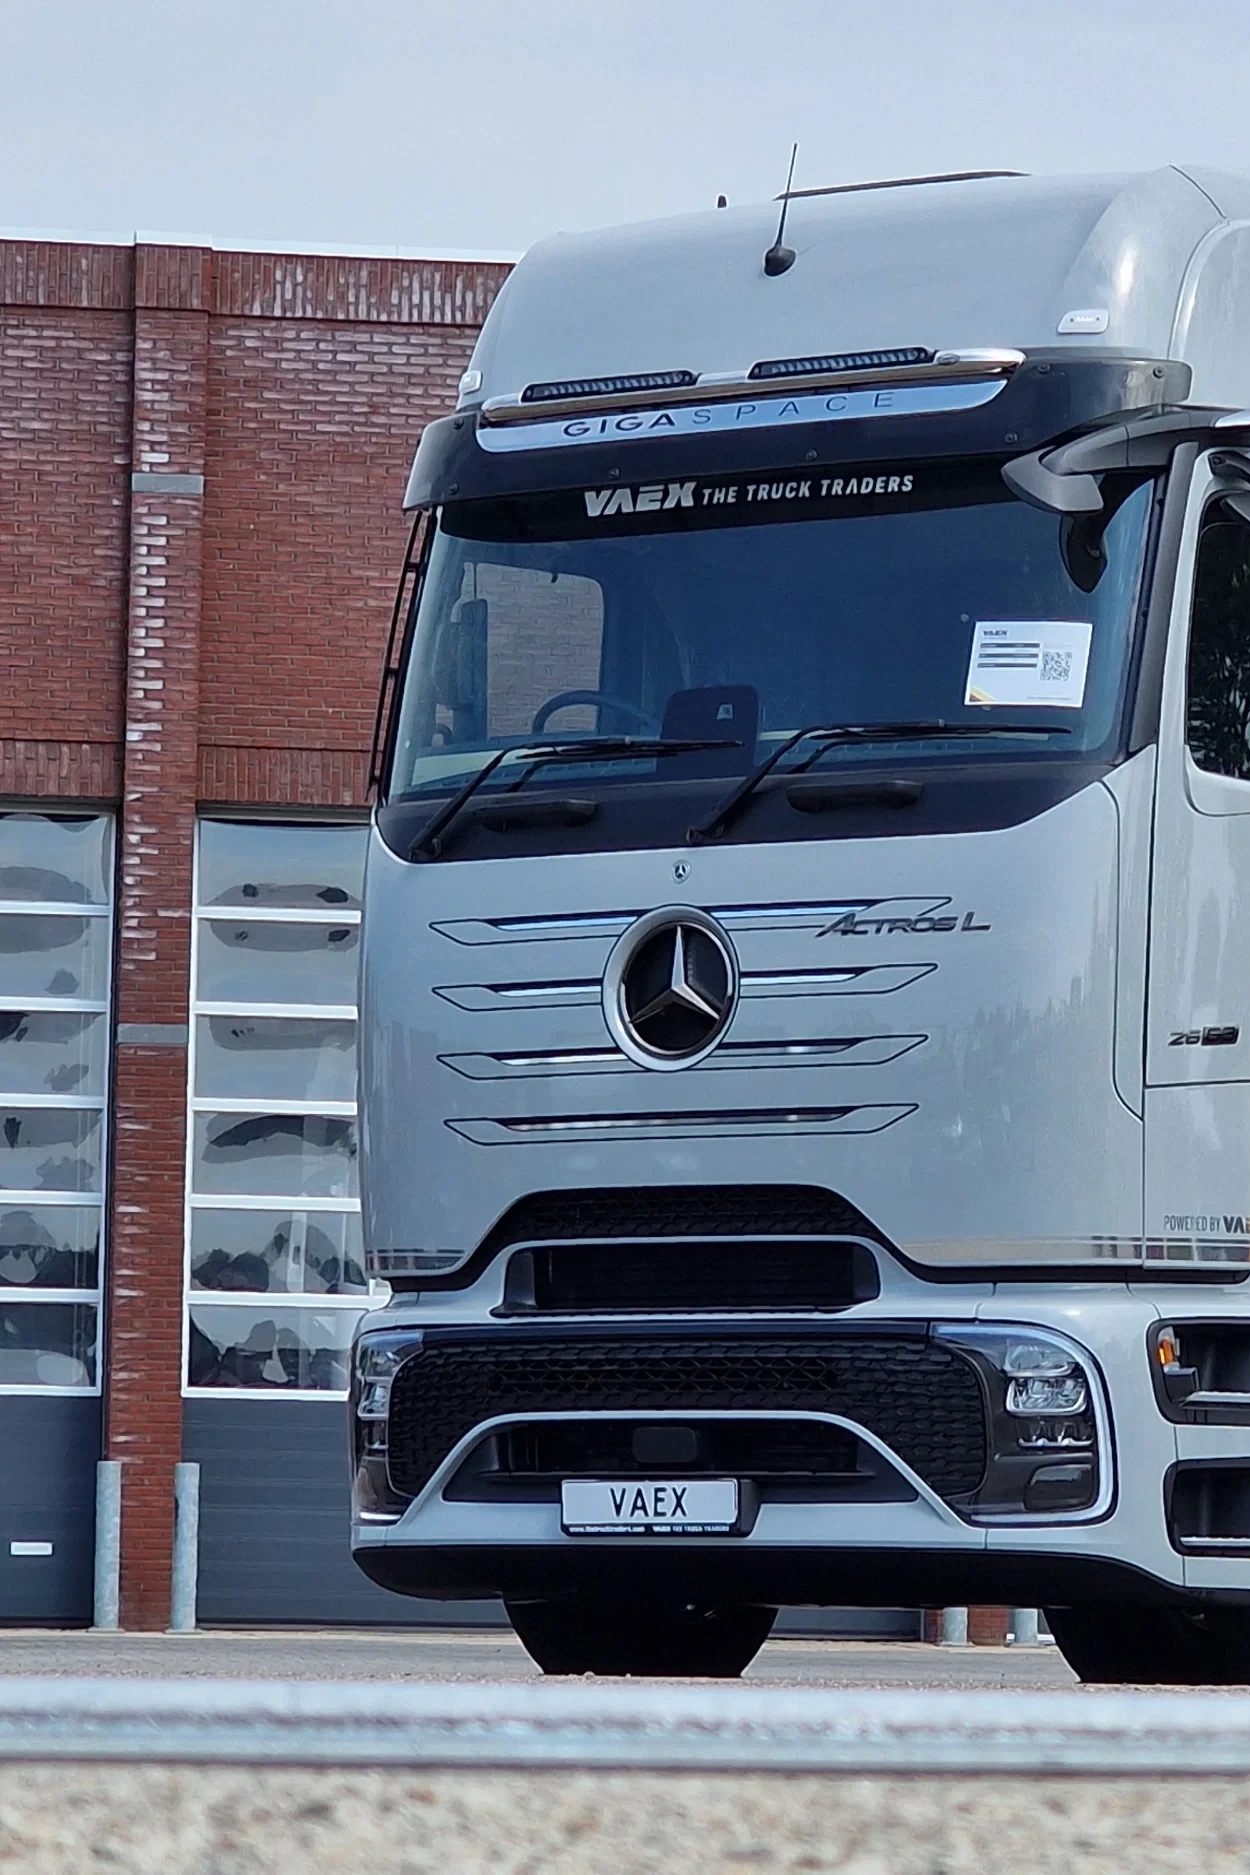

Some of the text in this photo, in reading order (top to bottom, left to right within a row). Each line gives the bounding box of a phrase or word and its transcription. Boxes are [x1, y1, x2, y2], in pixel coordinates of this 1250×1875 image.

[563, 391, 894, 437] GIGASPACE
[584, 475, 914, 517] VAEX THE TRUCK TRADERS
[961, 912, 991, 931] L
[1164, 1215, 1207, 1231] POWERED
[1209, 1216, 1221, 1231] BY
[609, 1487, 688, 1518] VAEX
